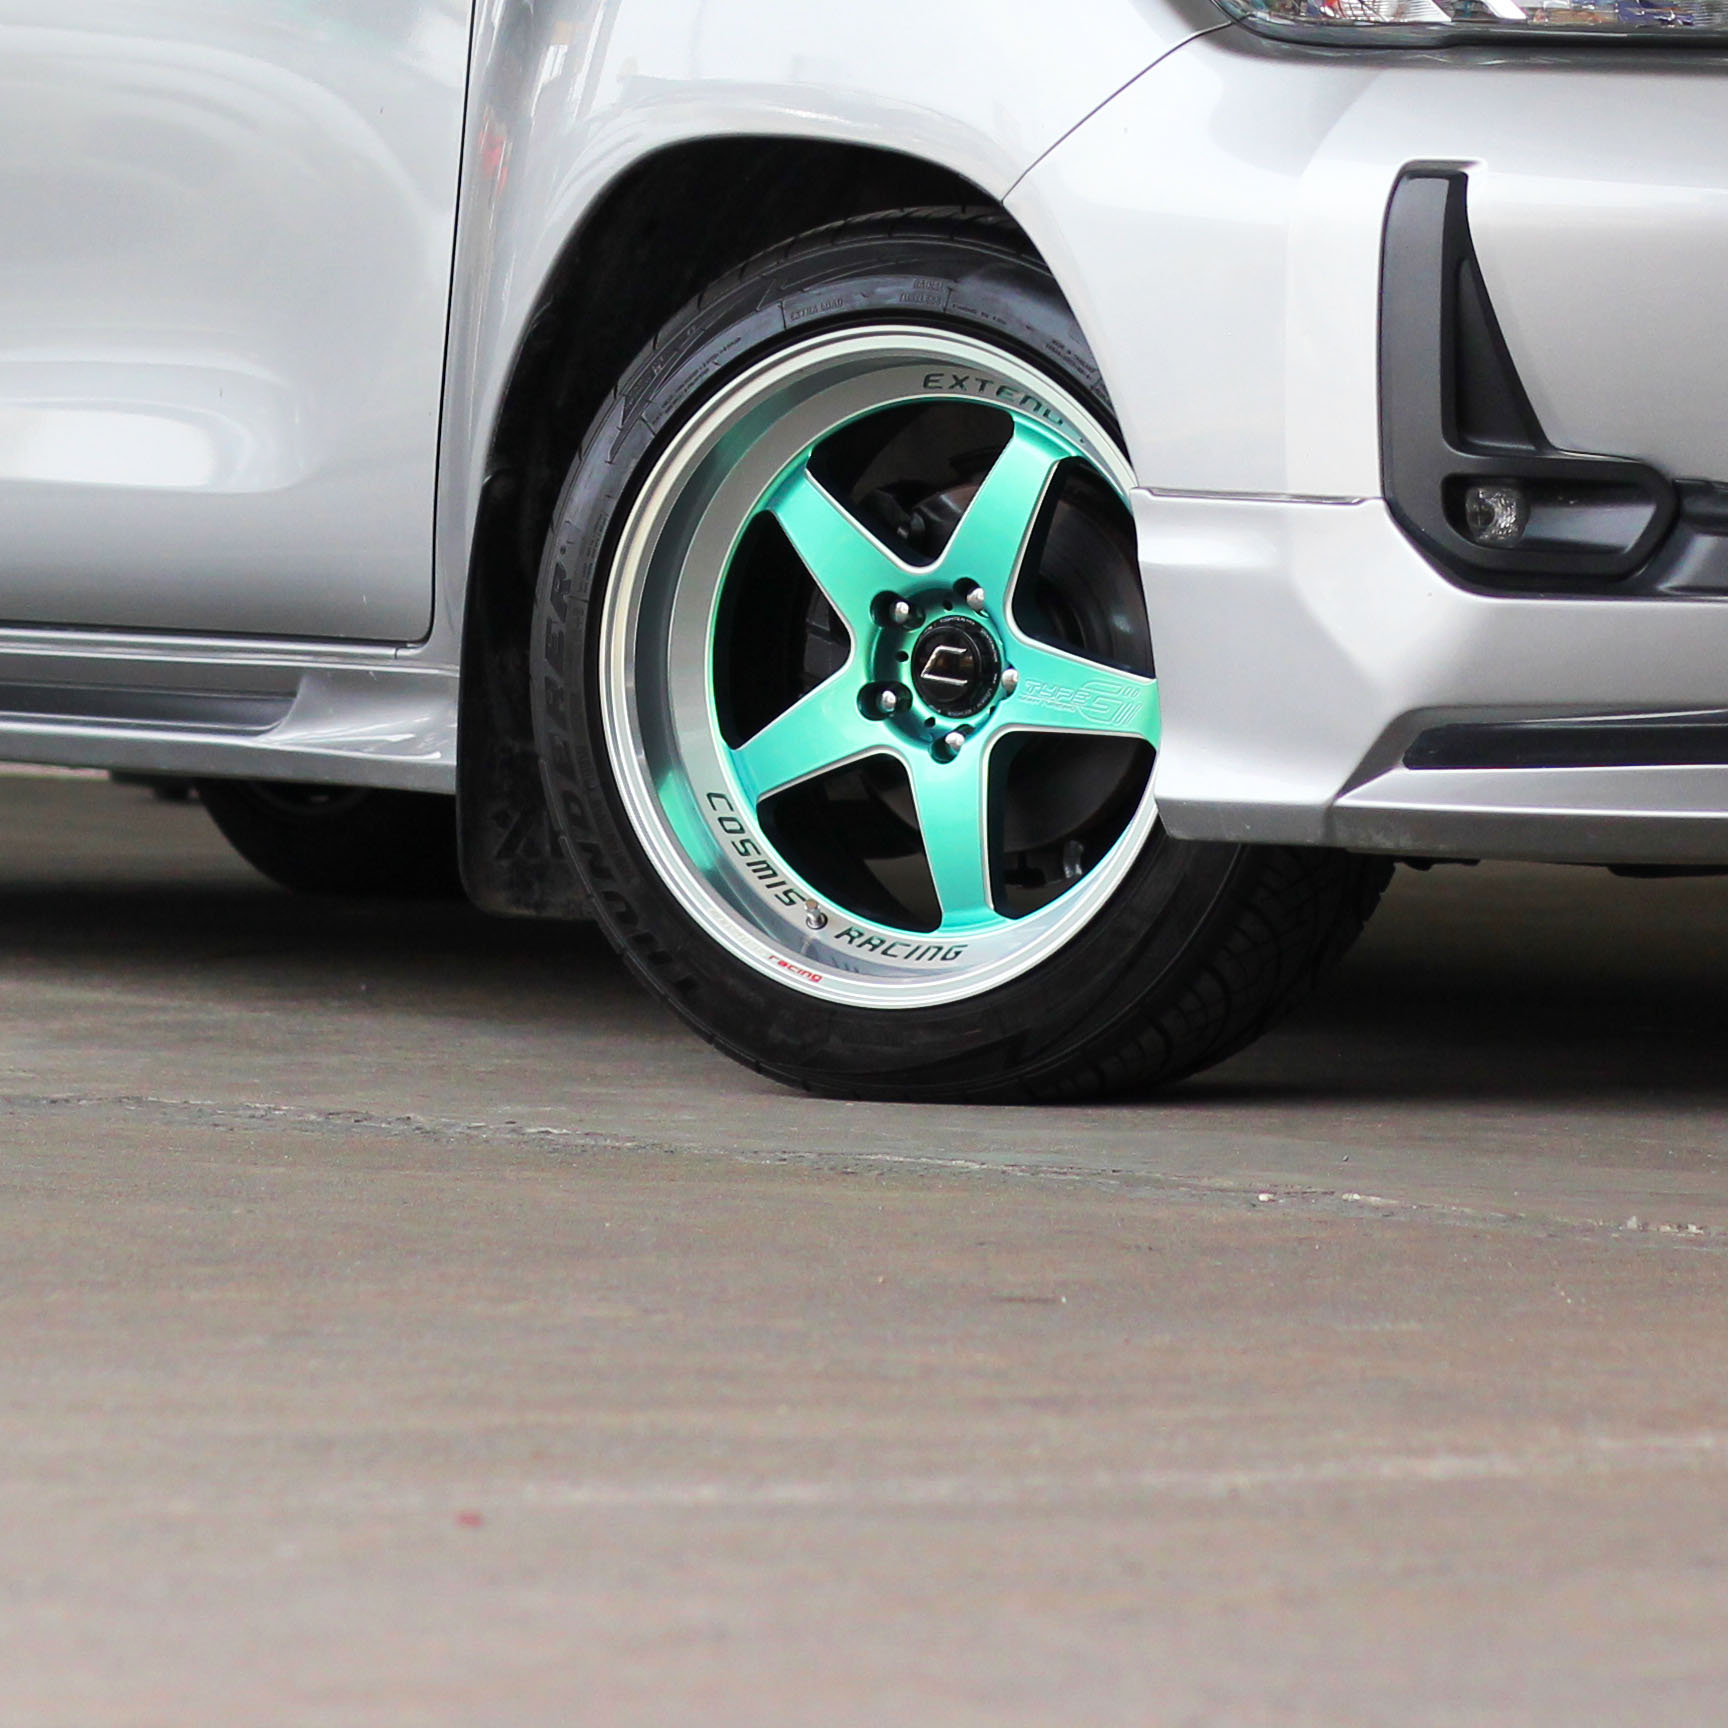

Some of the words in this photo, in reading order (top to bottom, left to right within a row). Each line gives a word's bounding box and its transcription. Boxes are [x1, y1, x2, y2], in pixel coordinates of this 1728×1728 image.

[706, 791, 807, 907] COSMIS
[834, 926, 968, 962] RACING
[768, 954, 823, 983] racing
